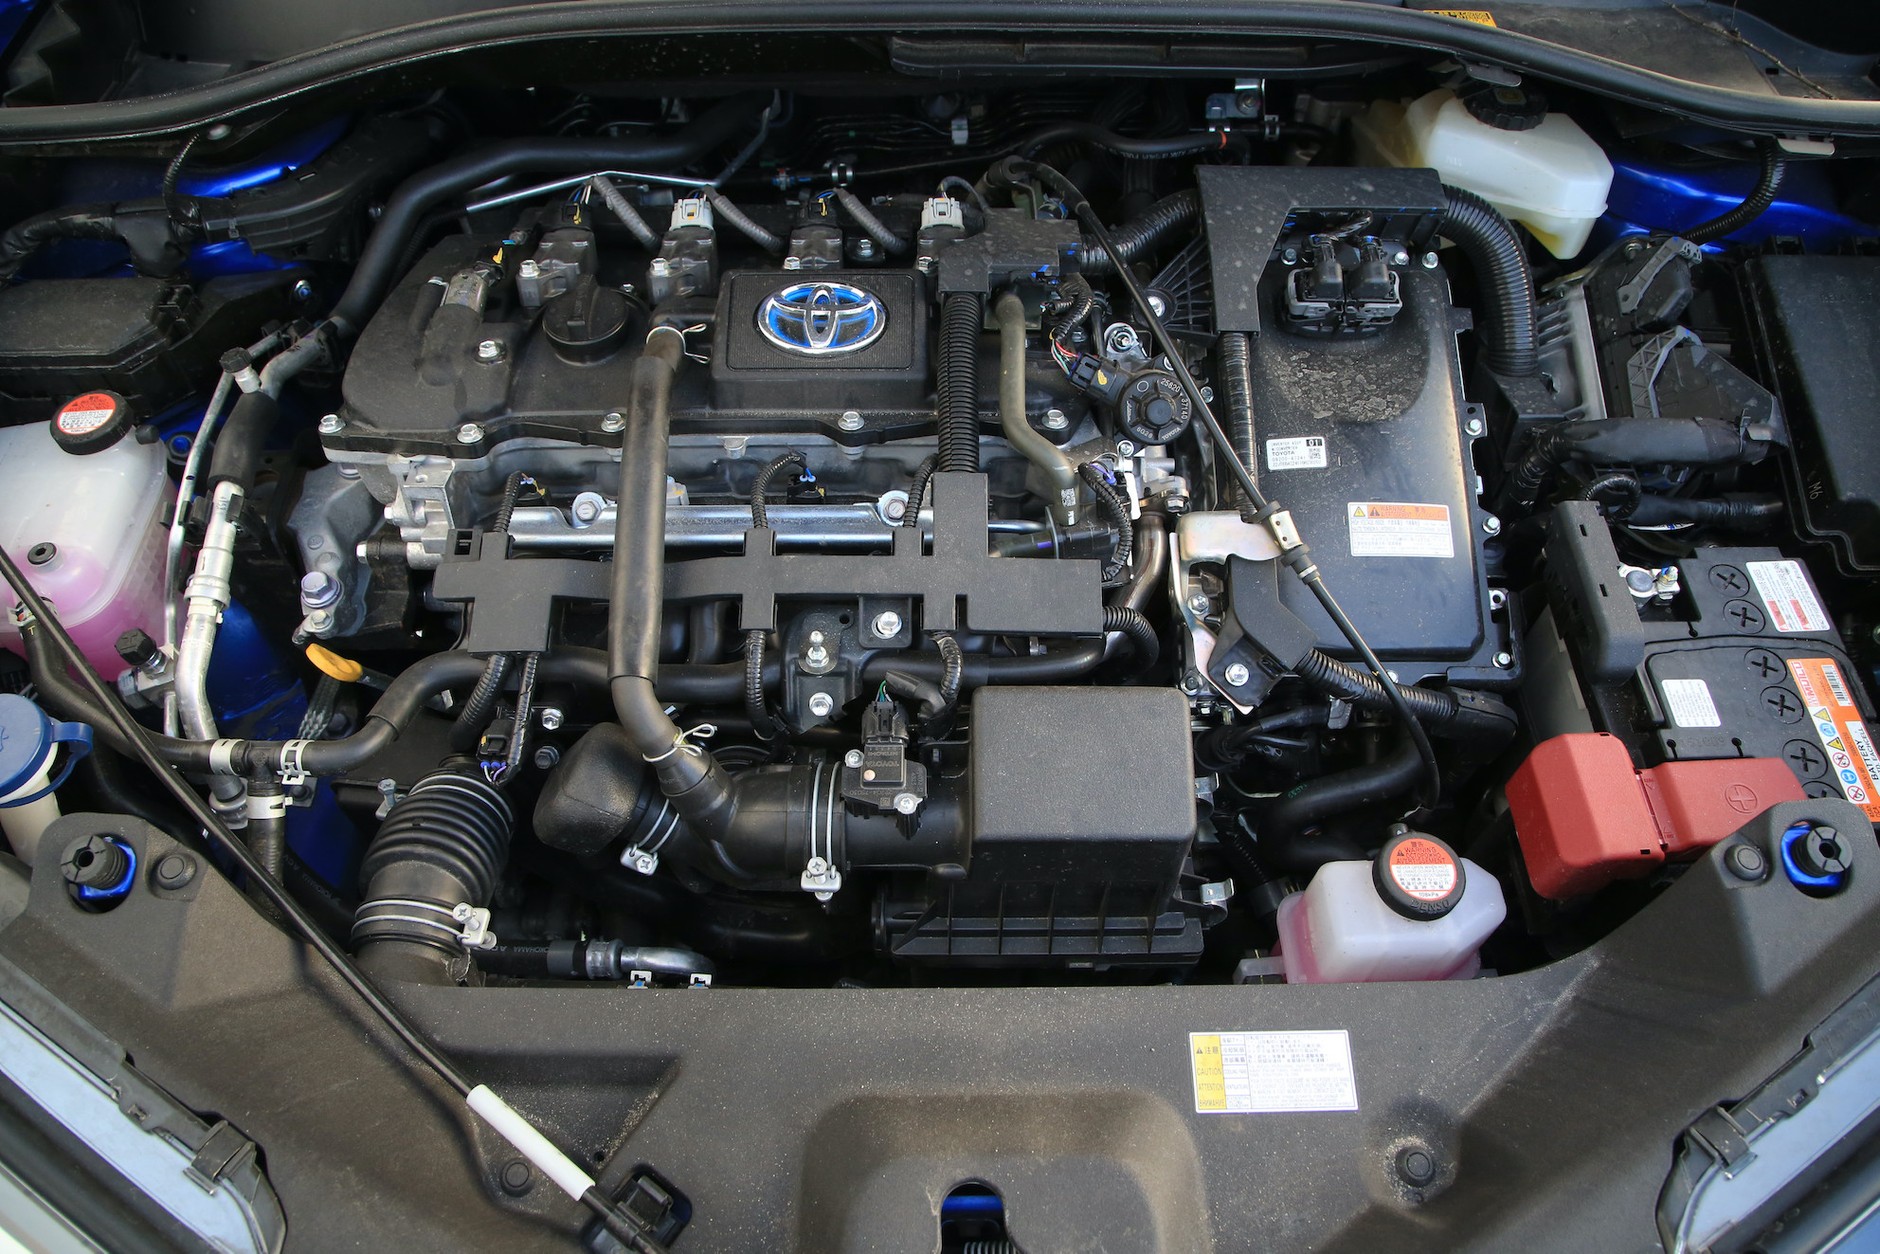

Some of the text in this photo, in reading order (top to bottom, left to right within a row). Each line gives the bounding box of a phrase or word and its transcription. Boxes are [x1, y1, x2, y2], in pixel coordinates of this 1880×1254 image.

[1160, 378, 1181, 393] 25620
[1181, 398, 1189, 420] 37140
[1161, 427, 1182, 441] TOYOTA
[1855, 739, 1879, 780] BATTERY
[1410, 900, 1450, 912] DENSO
[1197, 1067, 1222, 1076] CAUTION
[1198, 1082, 1224, 1091] ATTENTION
